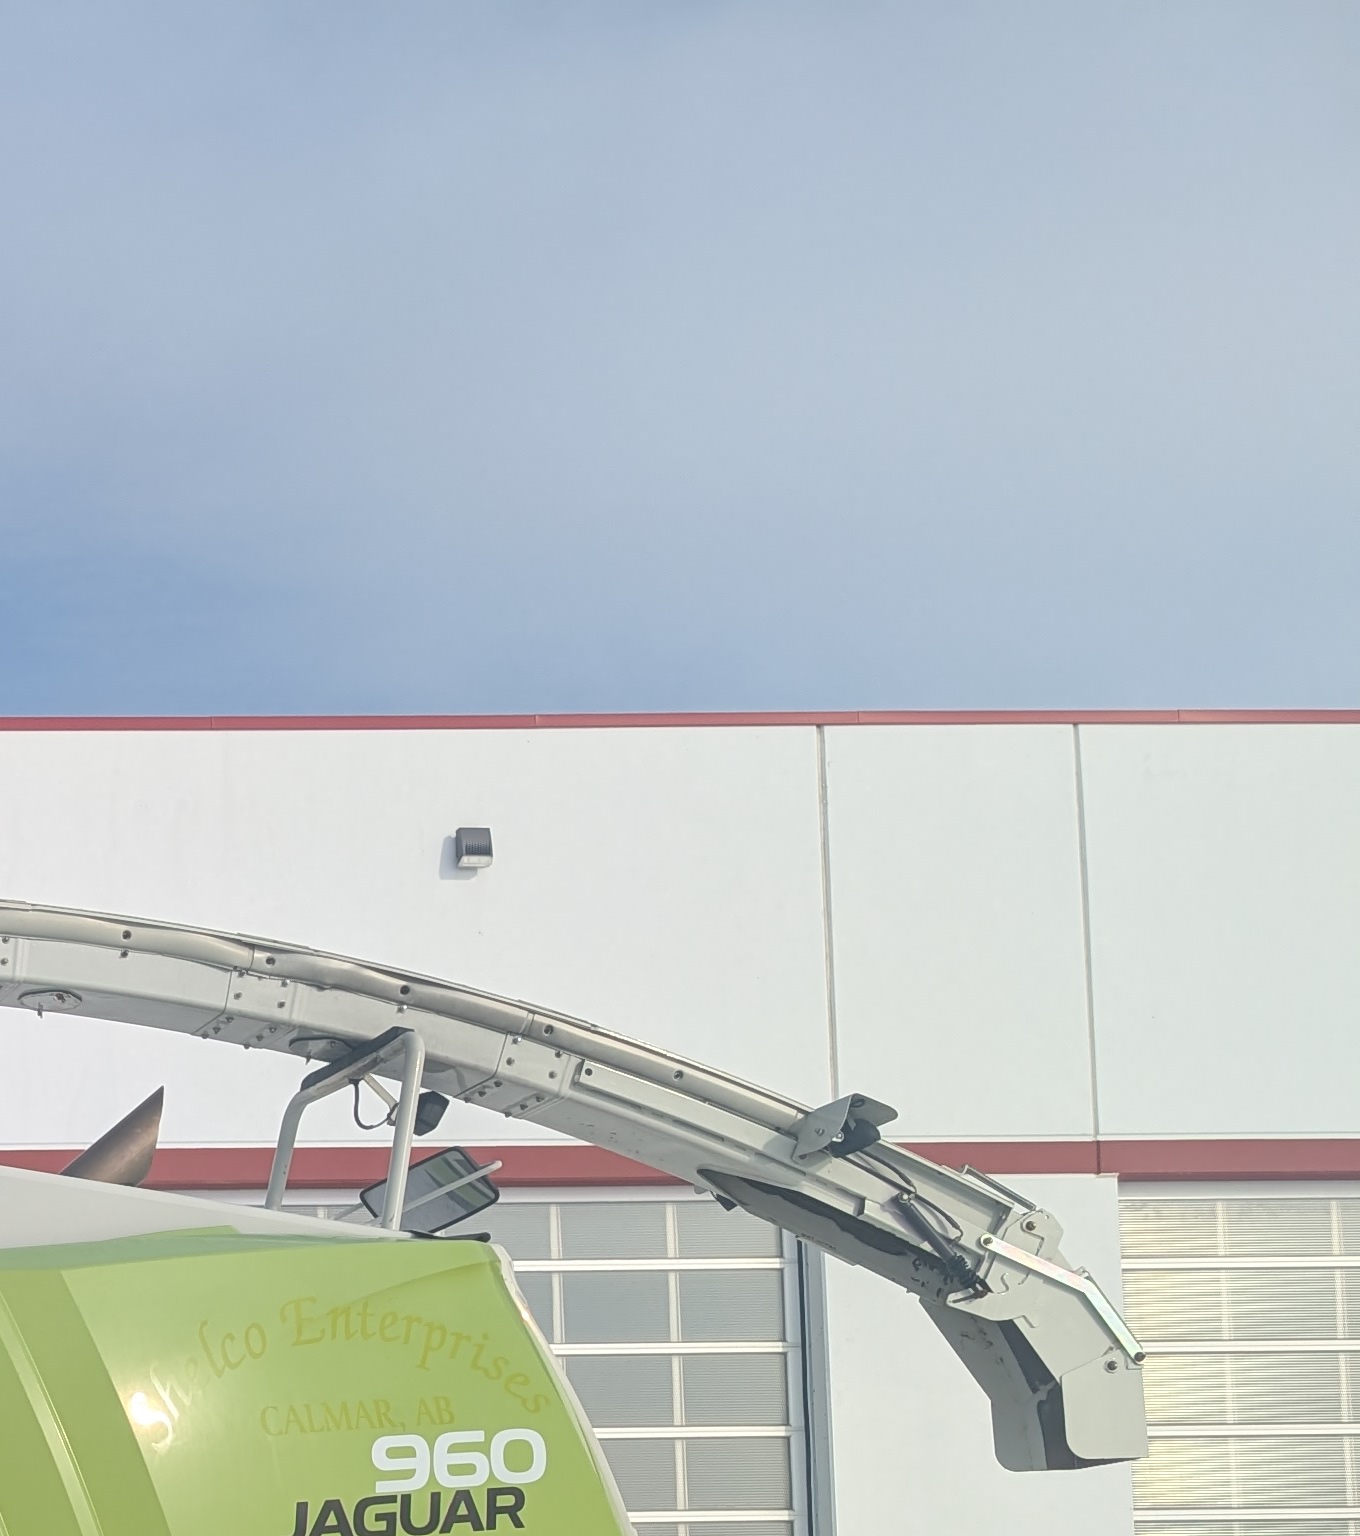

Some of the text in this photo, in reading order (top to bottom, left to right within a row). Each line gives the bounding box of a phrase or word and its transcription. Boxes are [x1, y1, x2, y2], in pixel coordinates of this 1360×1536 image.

[280, 1296, 551, 1414] Enterprises
[259, 1396, 456, 1437] CALMAR, AB
[371, 1428, 547, 1493] 960
